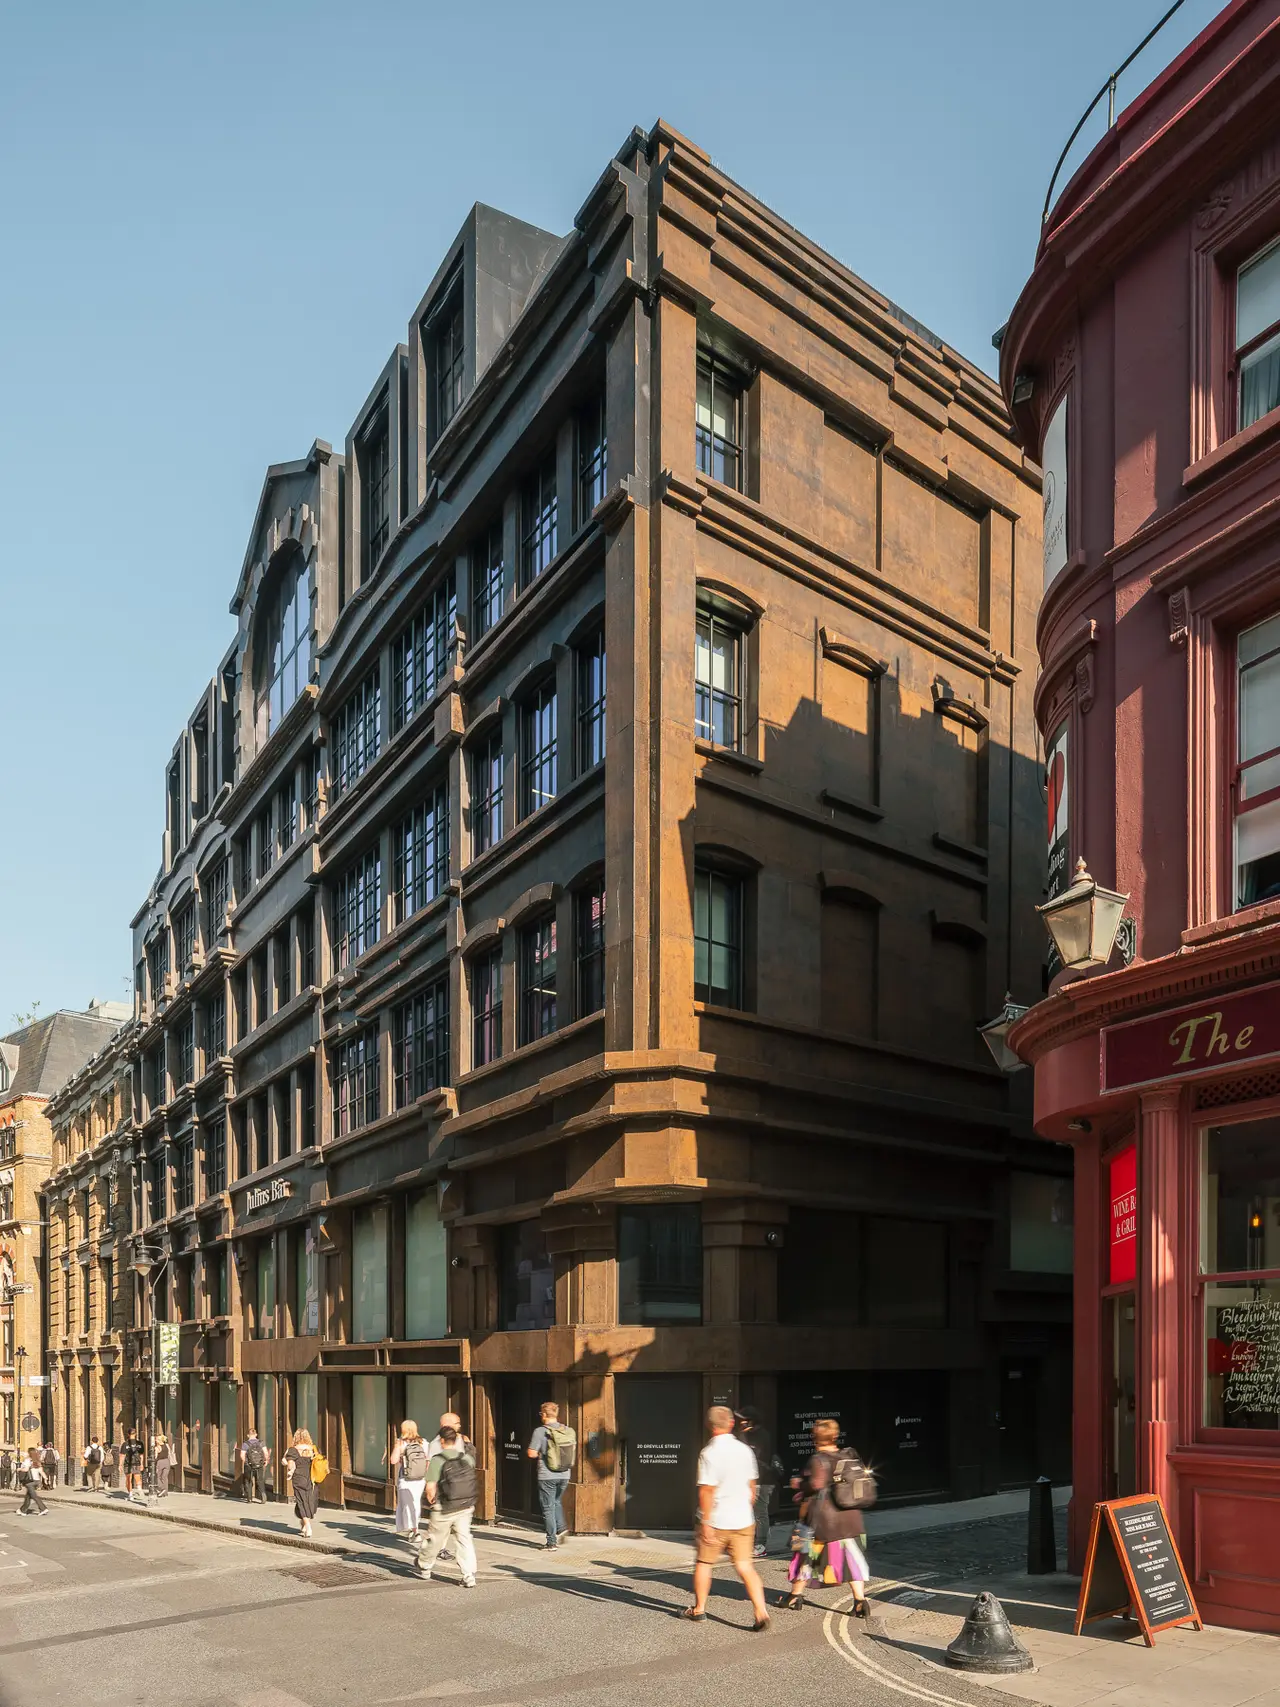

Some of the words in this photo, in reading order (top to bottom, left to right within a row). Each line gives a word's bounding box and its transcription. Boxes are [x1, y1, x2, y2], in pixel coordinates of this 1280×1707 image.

[1169, 1012, 1254, 1065] The
[246, 1188, 270, 1216] Julius
[1113, 1197, 1130, 1219] WINE
[1130, 1195, 1136, 1212] B
[1115, 1223, 1121, 1238] &
[1217, 1308, 1265, 1327] Bleeding
